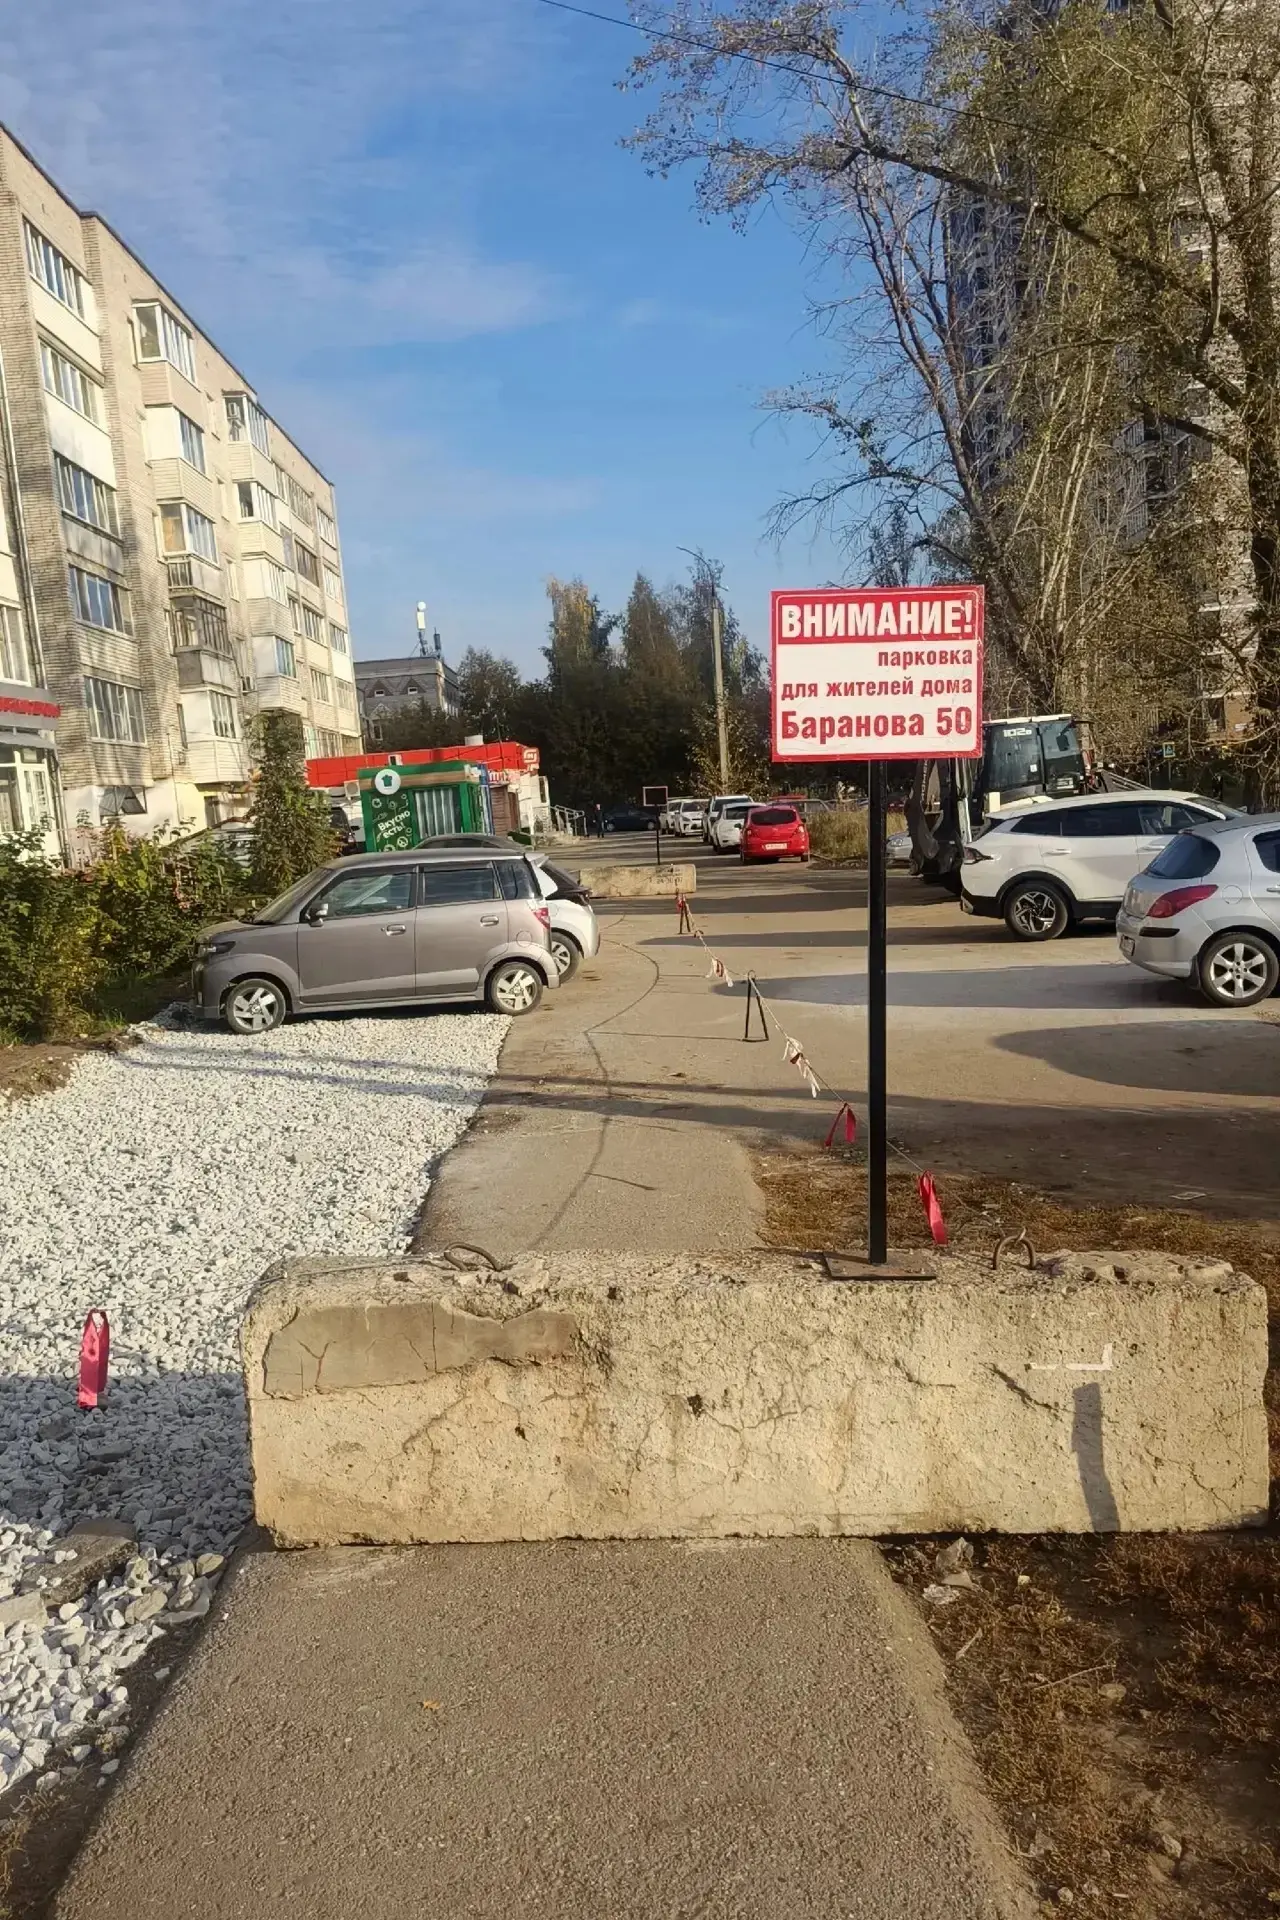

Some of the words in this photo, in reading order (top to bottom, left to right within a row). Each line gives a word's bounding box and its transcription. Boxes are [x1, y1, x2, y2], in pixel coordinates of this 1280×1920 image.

[781, 600, 973, 638] ВНИМАНИЕ!
[878, 649, 973, 670] парковка
[781, 682, 818, 701] для
[826, 676, 914, 697] жителей
[920, 678, 973, 698] дома
[781, 711, 925, 745] Баранова
[936, 706, 973, 736] 50
